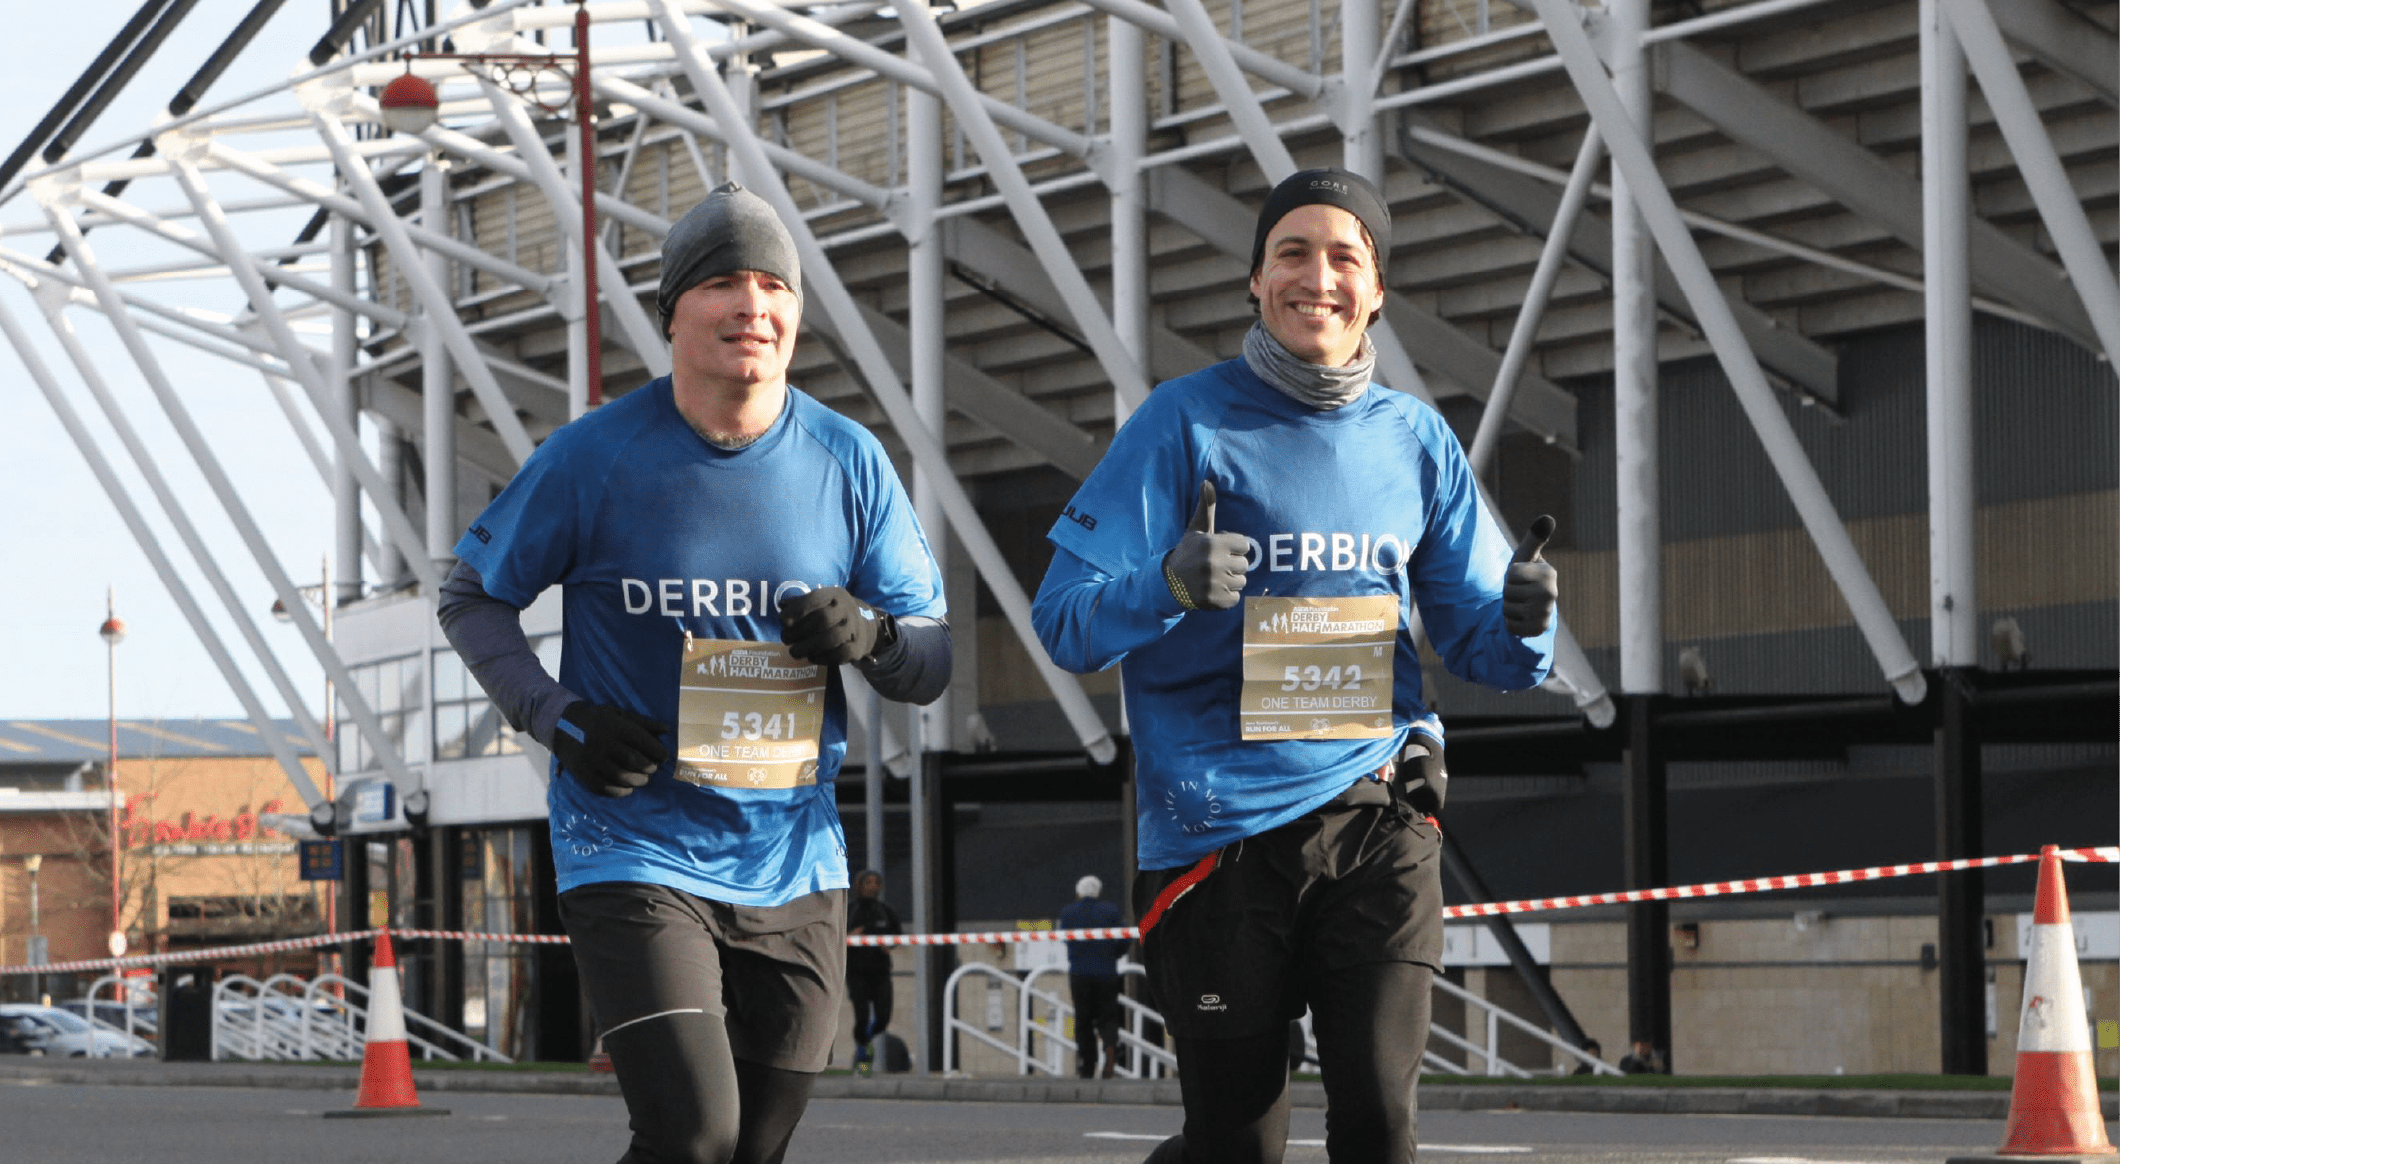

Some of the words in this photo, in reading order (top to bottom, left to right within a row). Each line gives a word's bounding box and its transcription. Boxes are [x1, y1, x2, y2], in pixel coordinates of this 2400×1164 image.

[621, 578, 840, 618] DERBIO
[1291, 612, 1328, 622] DERBY
[1292, 622, 1320, 633] HALF
[1321, 620, 1385, 634] MARATHON
[1373, 646, 1383, 658] M
[730, 655, 768, 667] DERBY
[730, 667, 760, 678] HALF
[761, 664, 818, 680] MARATHON
[1281, 664, 1362, 692] 5342
[1261, 697, 1290, 710] ONE
[1292, 696, 1329, 709] TEAM
[1332, 695, 1377, 708] DERBY
[720, 711, 795, 741] 5341
[700, 744, 730, 758] ONE
[734, 745, 769, 759] TEAM
